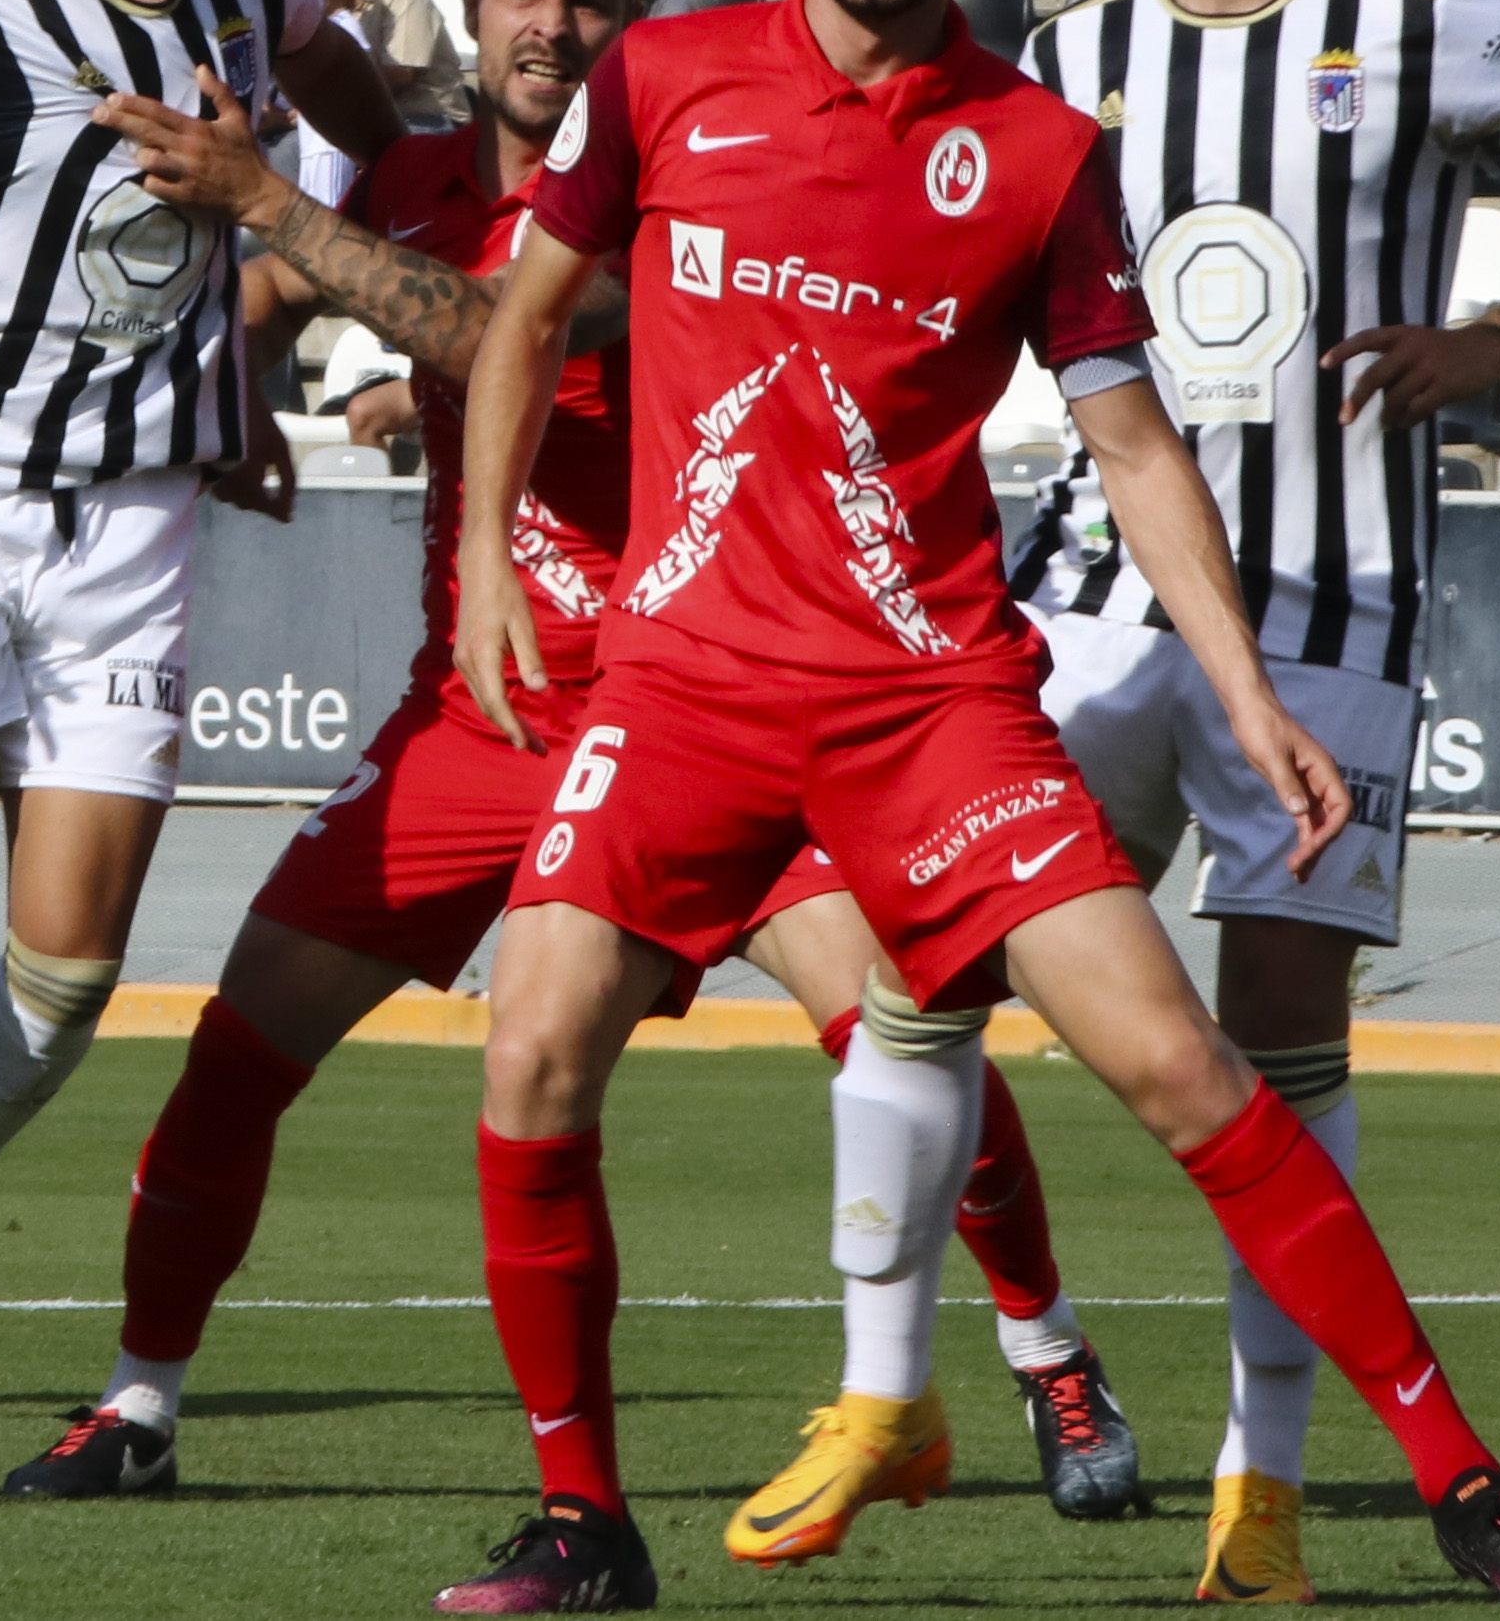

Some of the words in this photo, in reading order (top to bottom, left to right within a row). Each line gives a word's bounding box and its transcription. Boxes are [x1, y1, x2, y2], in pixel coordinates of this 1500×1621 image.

[731, 254, 880, 318] afar
[100, 309, 166, 337] Civitas
[1182, 377, 1262, 402] Civitas
[553, 725, 630, 813] 6
[907, 829, 968, 887] GRAN
[962, 793, 1042, 842] PLAZA
